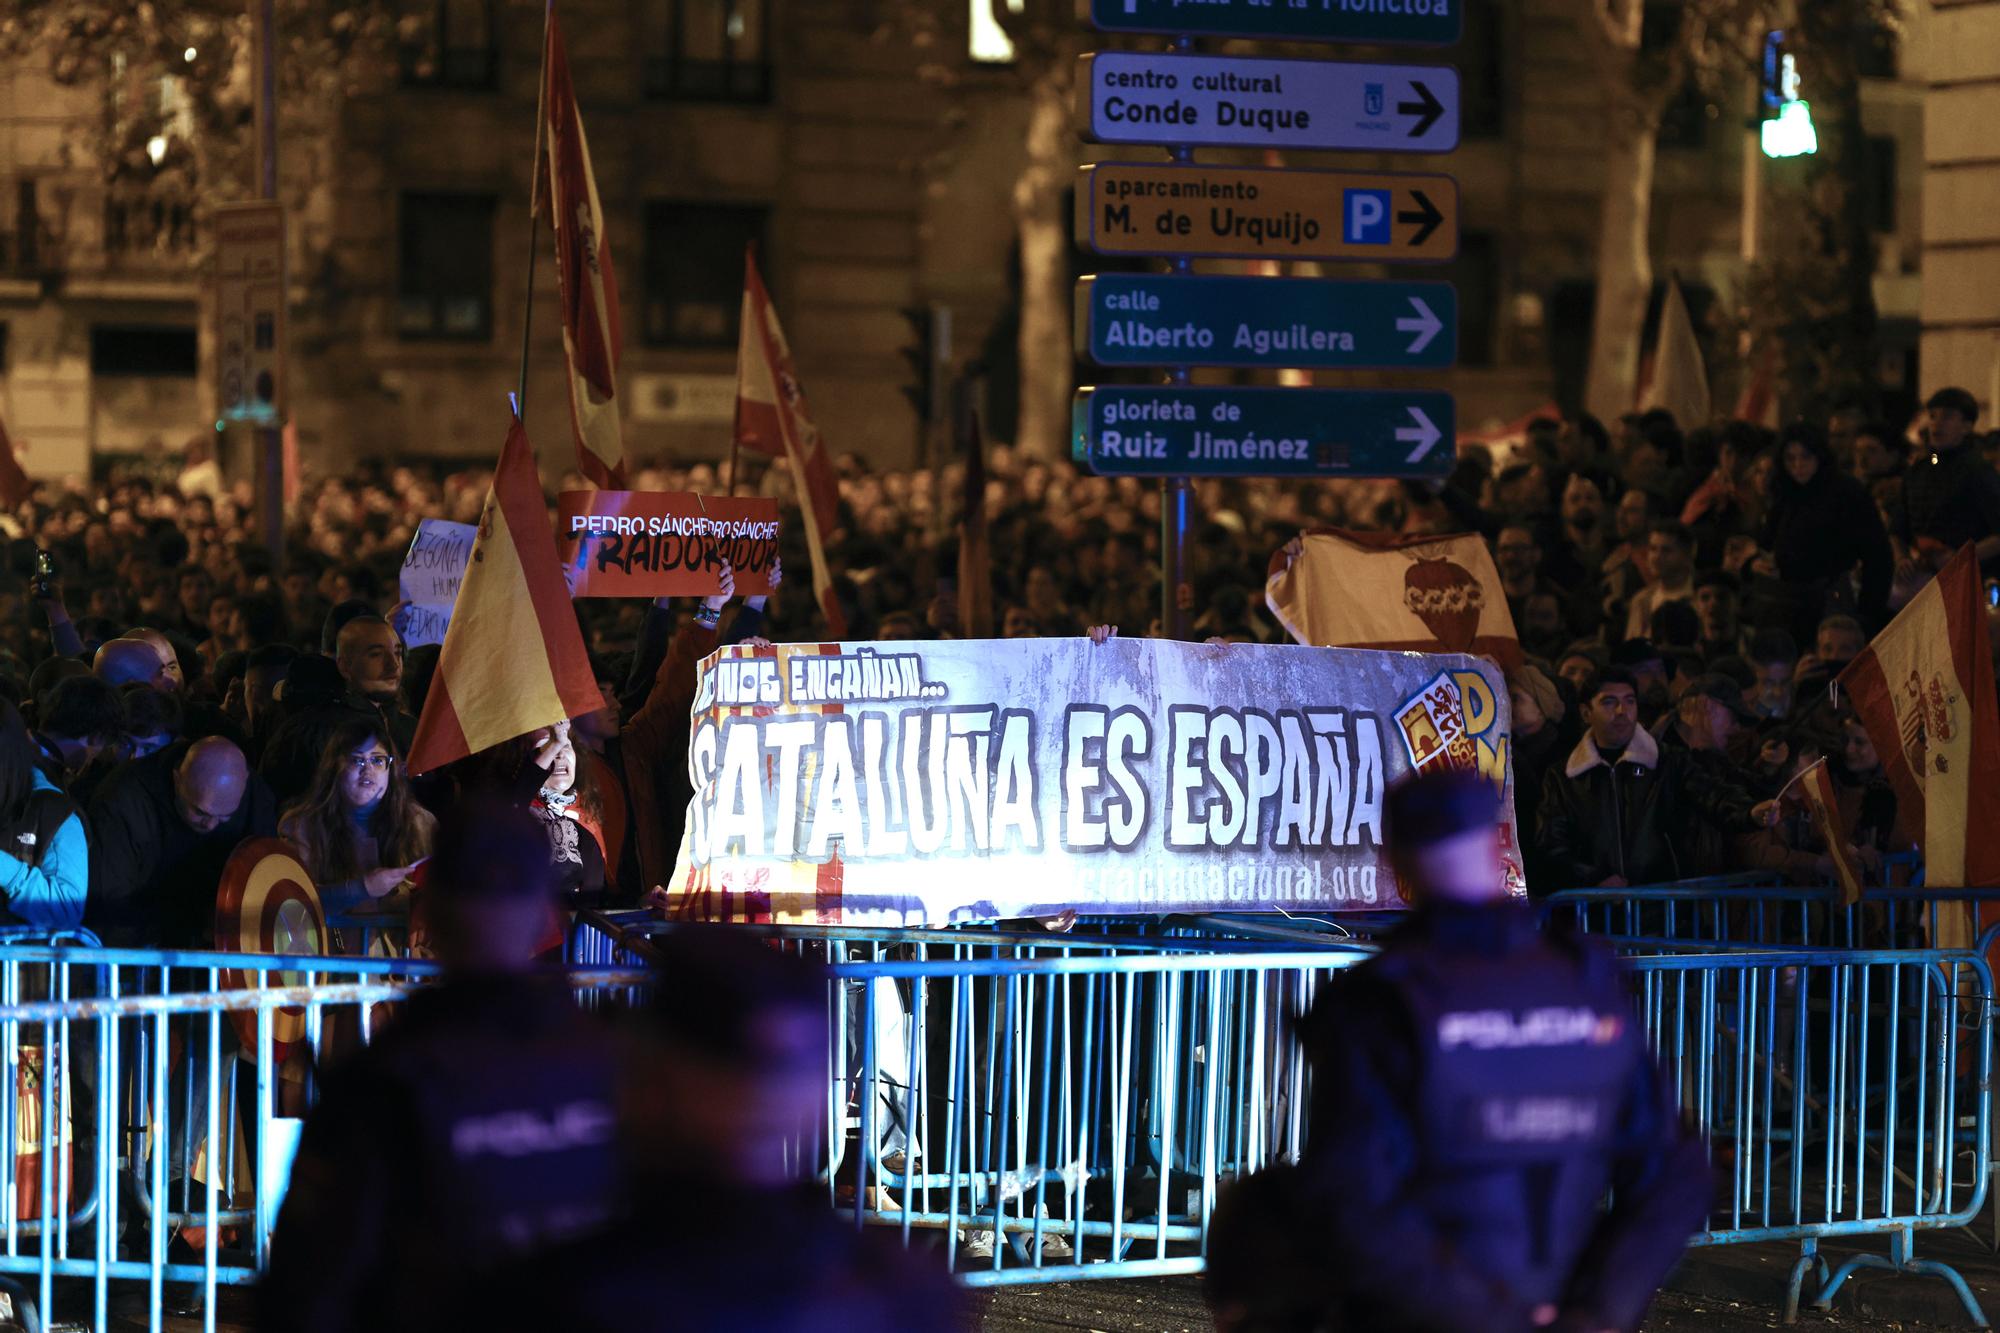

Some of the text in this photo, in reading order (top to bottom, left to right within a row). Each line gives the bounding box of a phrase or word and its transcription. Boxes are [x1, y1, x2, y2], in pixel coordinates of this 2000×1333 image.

[1104, 70, 1283, 94] centro cultural
[1104, 97, 1311, 134] Conde Duque
[1104, 177, 1259, 204] aparcamiento
[1104, 205, 1320, 246] M. de Urquijo
[1351, 194, 1384, 241] P
[1105, 290, 1160, 311] calle
[1105, 321, 1355, 355] Alberto Aguilera
[1103, 400, 1241, 424] glorieta de
[1102, 431, 1309, 459] Ruiz Jiménez
[571, 513, 711, 536] PEDRO SÁNCHE
[708, 519, 731, 539] DRO
[566, 530, 721, 575] TRAIDOR
[719, 533, 778, 574] AIDOR
[433, 576, 462, 597] HUM
[408, 606, 440, 641] EDRO
[716, 661, 780, 703] NOS
[791, 651, 946, 702] ENGAÑAN...
[692, 706, 1385, 866] CATALUÑA ES ESPAÑA
